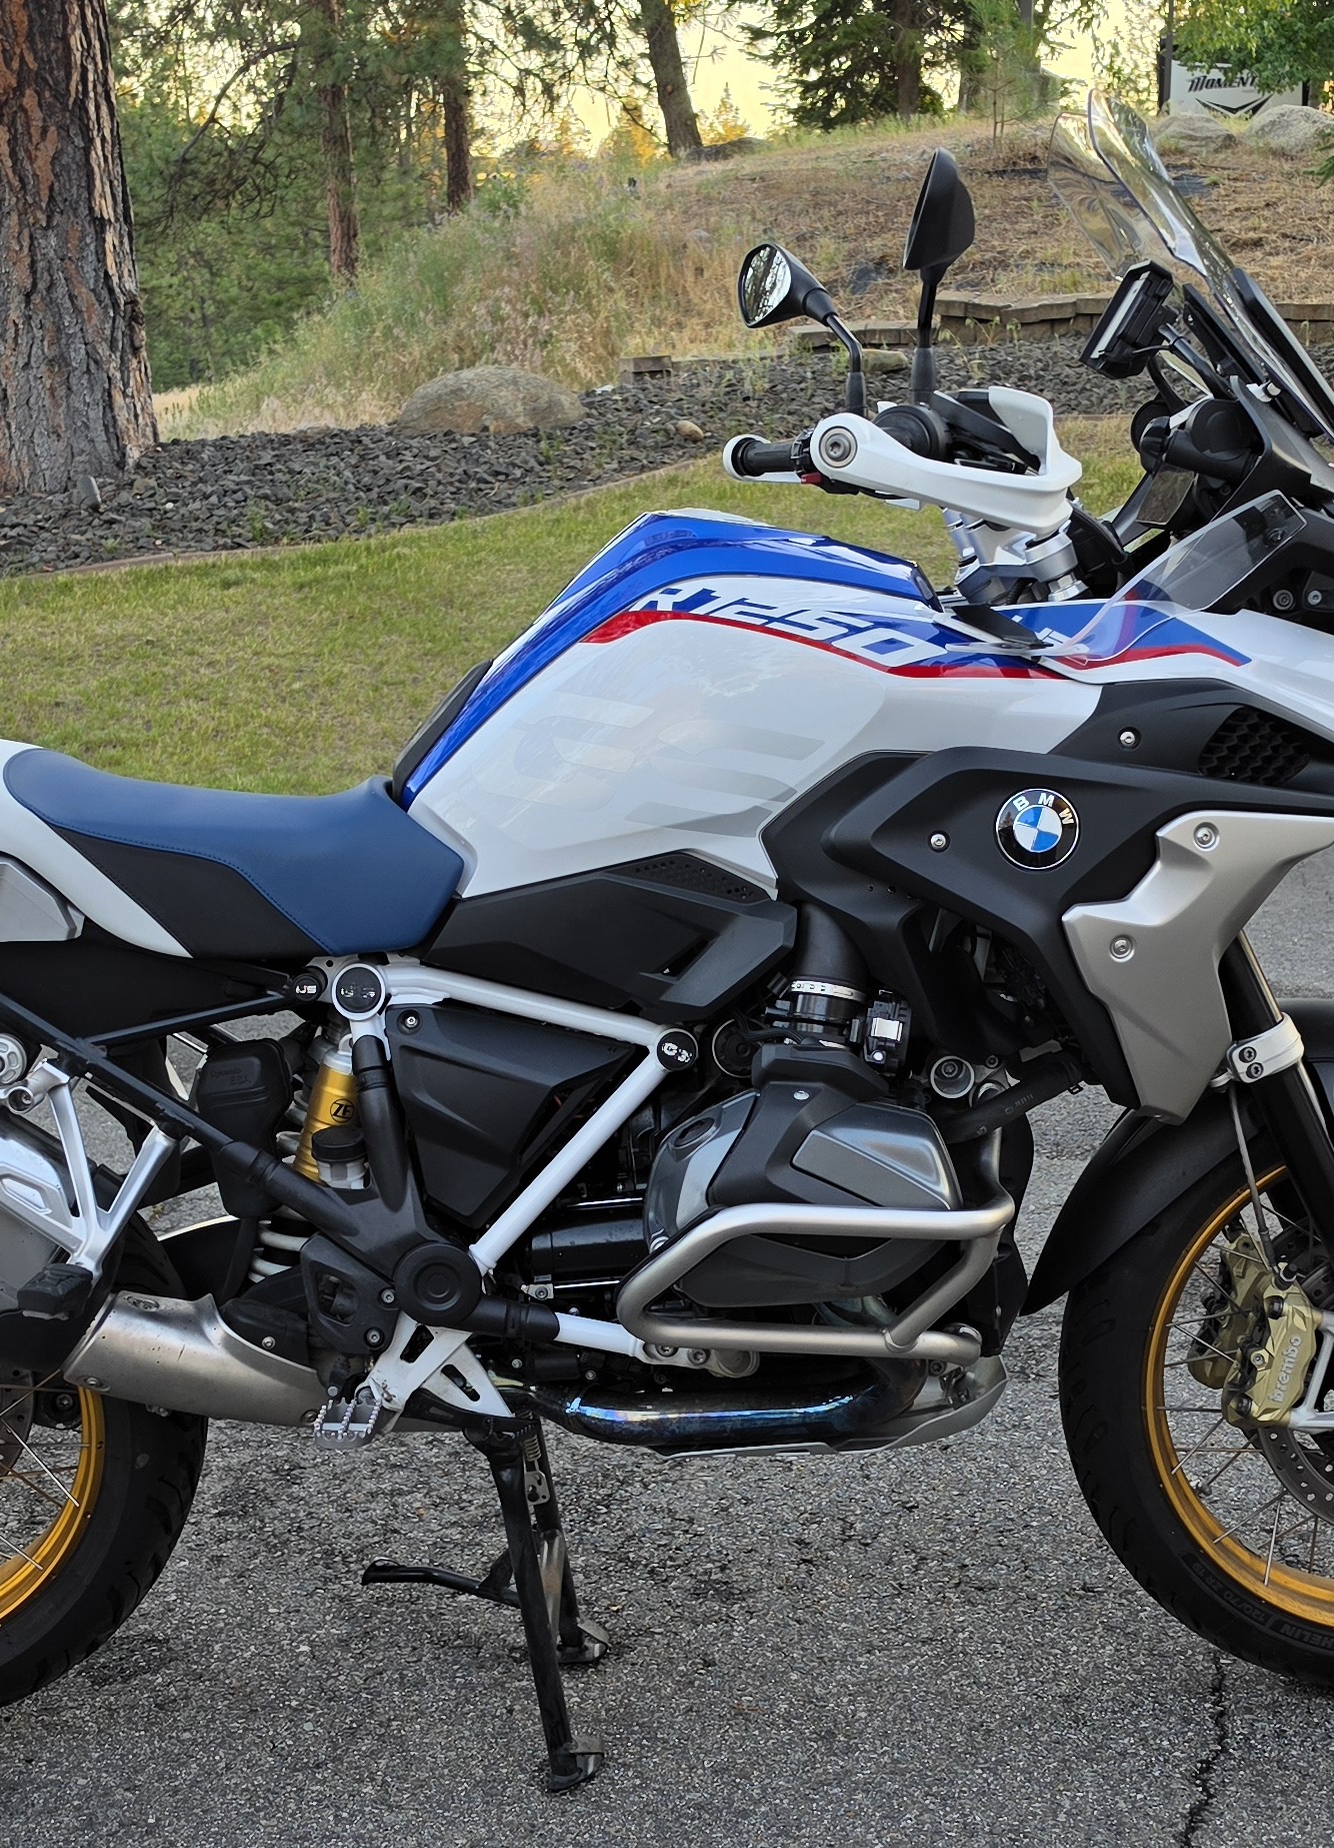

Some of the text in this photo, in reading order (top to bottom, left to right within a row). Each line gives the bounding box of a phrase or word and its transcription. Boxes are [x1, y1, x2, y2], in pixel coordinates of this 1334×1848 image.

[1013, 792, 1075, 825] BMW
[332, 1101, 355, 1120] ZF
[1267, 1335, 1302, 1403] brembo
